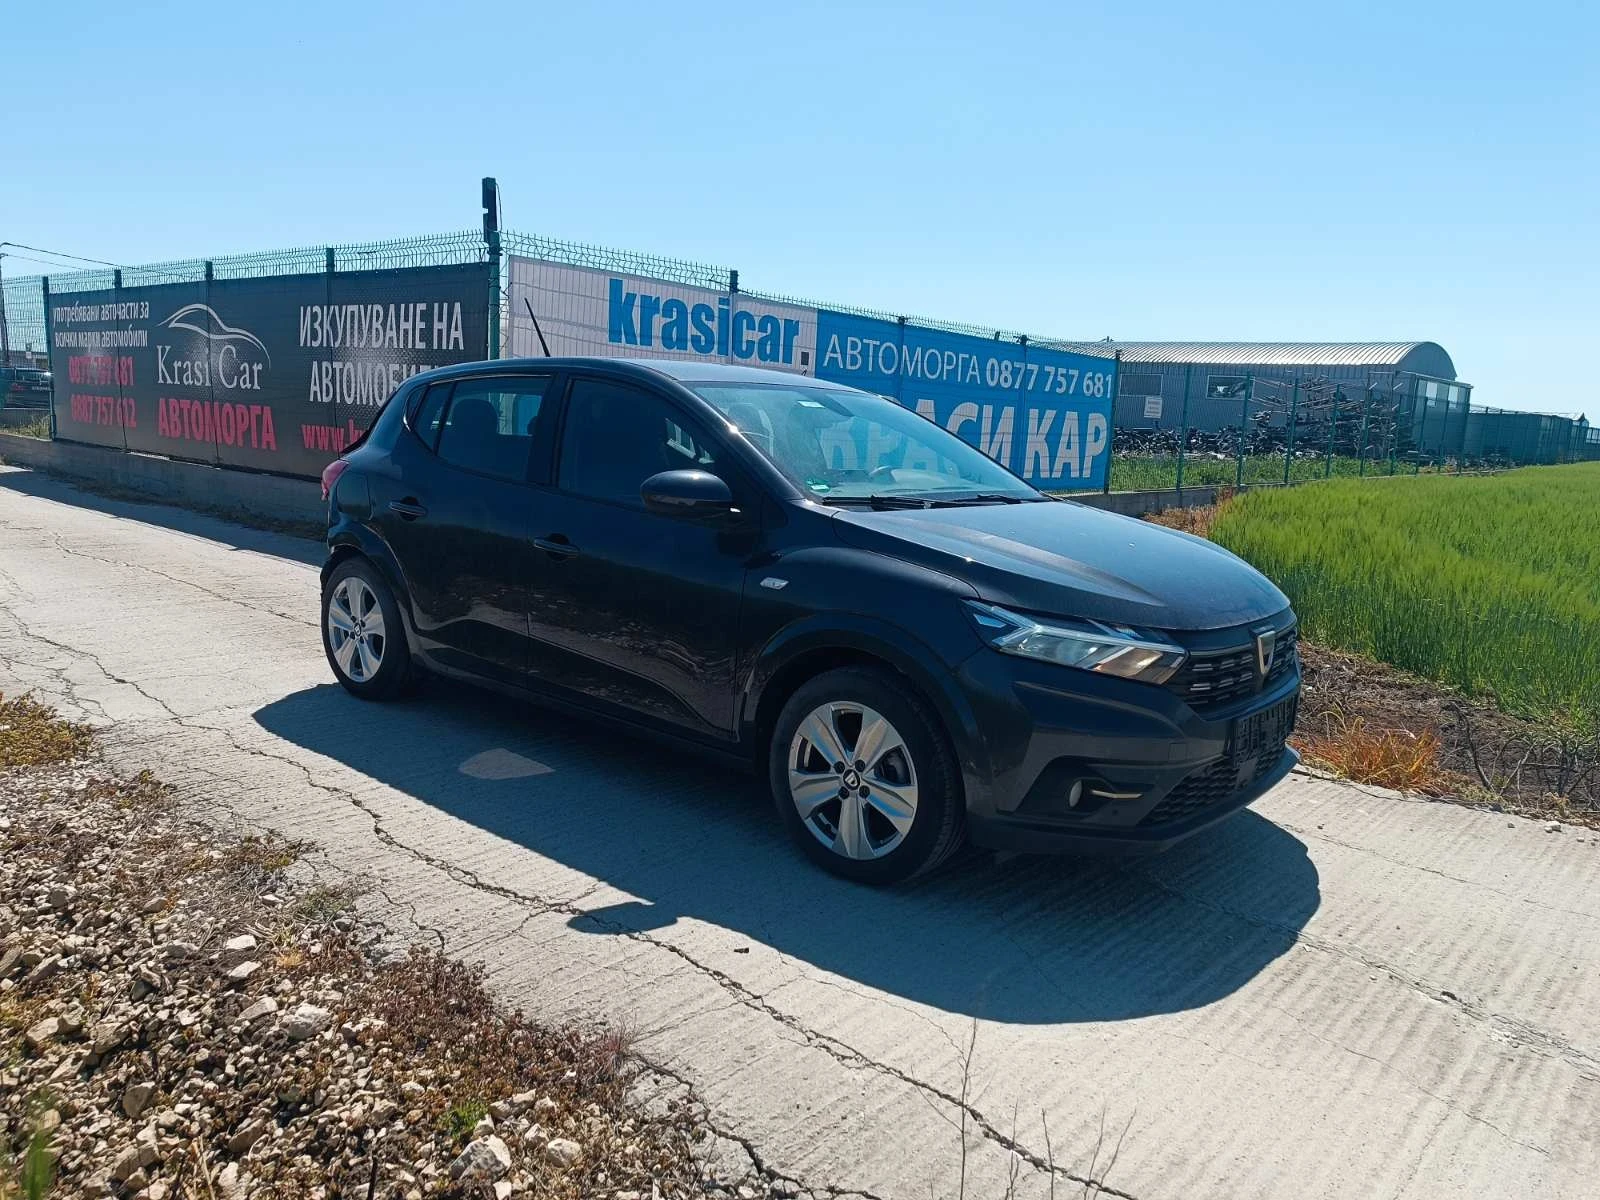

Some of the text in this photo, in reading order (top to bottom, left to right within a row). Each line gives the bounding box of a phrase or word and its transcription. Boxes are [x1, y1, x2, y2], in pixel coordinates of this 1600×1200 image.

[101, 302, 139, 322] авточасти
[140, 301, 149, 319] за
[101, 324, 148, 348] автомобили
[299, 301, 464, 350] ИЗКУПУВАНЕ НА
[608, 278, 799, 364] krasicar
[156, 344, 262, 390] Krasi Car
[823, 334, 1113, 399] АВТОМОРГА 0877 757 681
[158, 398, 277, 450] АВТОМОРГА
[1023, 408, 1107, 479] КАР
